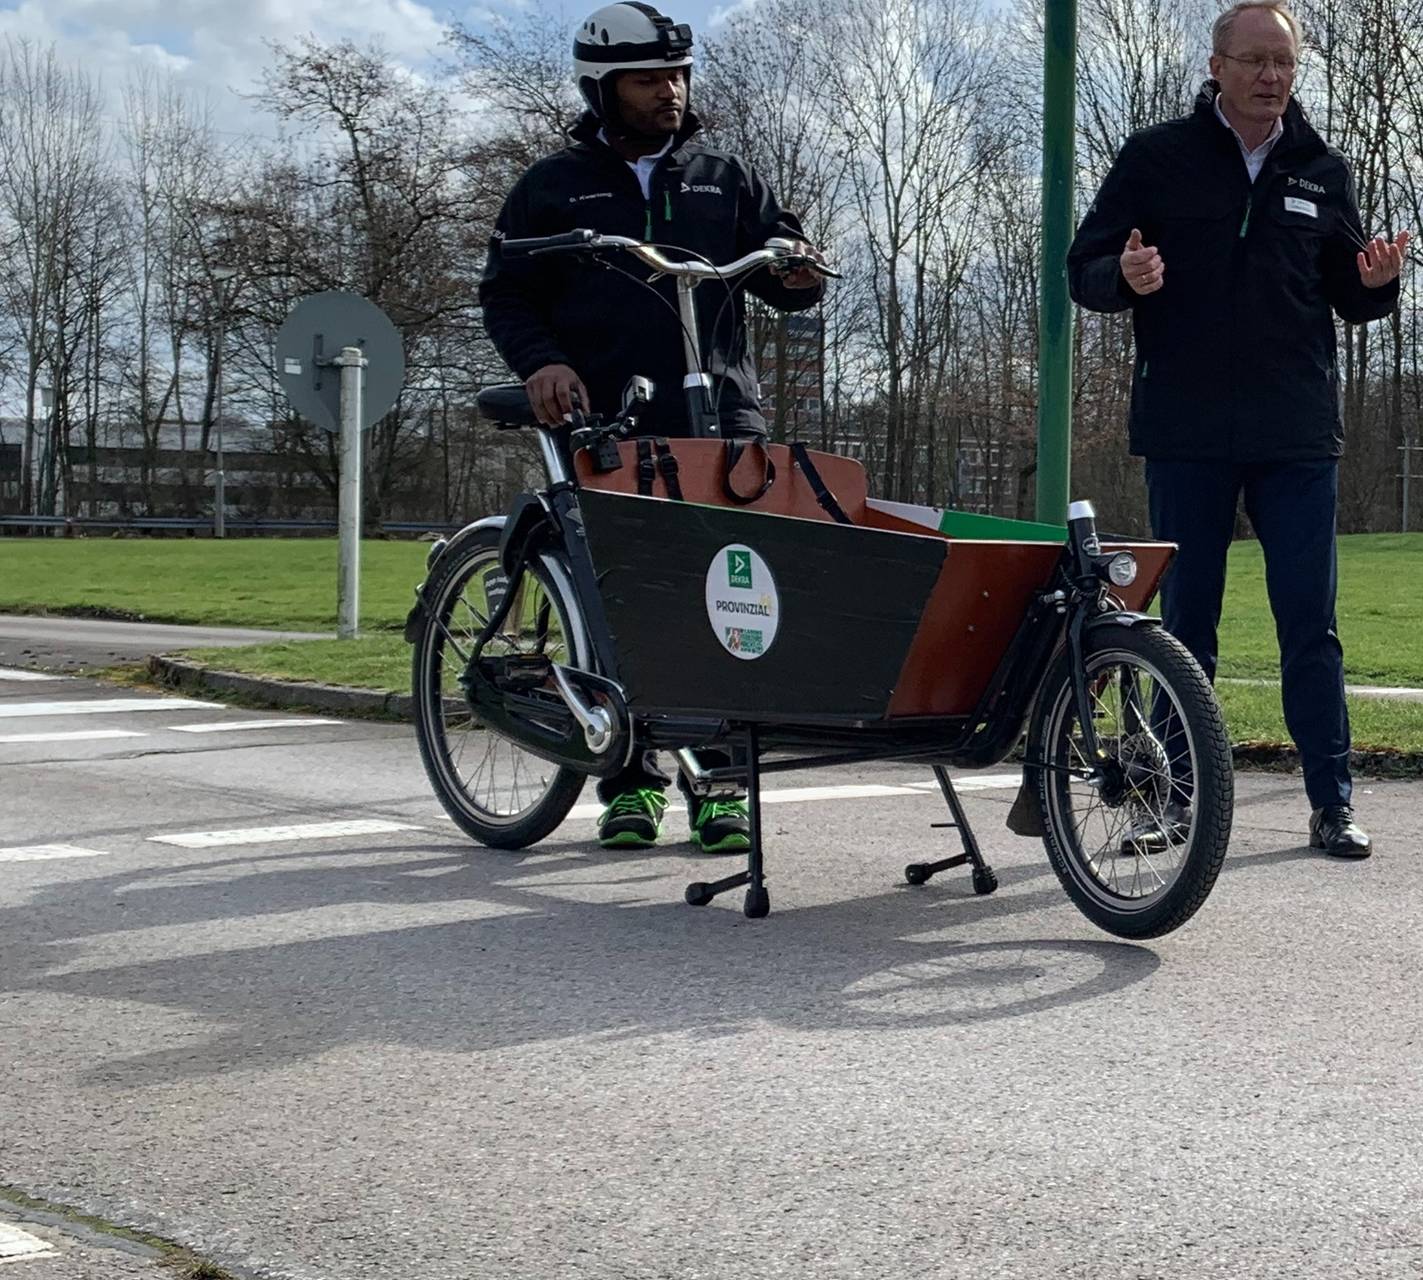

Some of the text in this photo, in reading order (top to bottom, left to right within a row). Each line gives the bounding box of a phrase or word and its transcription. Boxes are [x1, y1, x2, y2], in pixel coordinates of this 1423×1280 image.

[692, 184, 722, 195] DEKRA
[1299, 178, 1326, 194] DEKRA
[731, 575, 750, 585] DEKRA
[716, 600, 770, 617] PROVINZIAL
